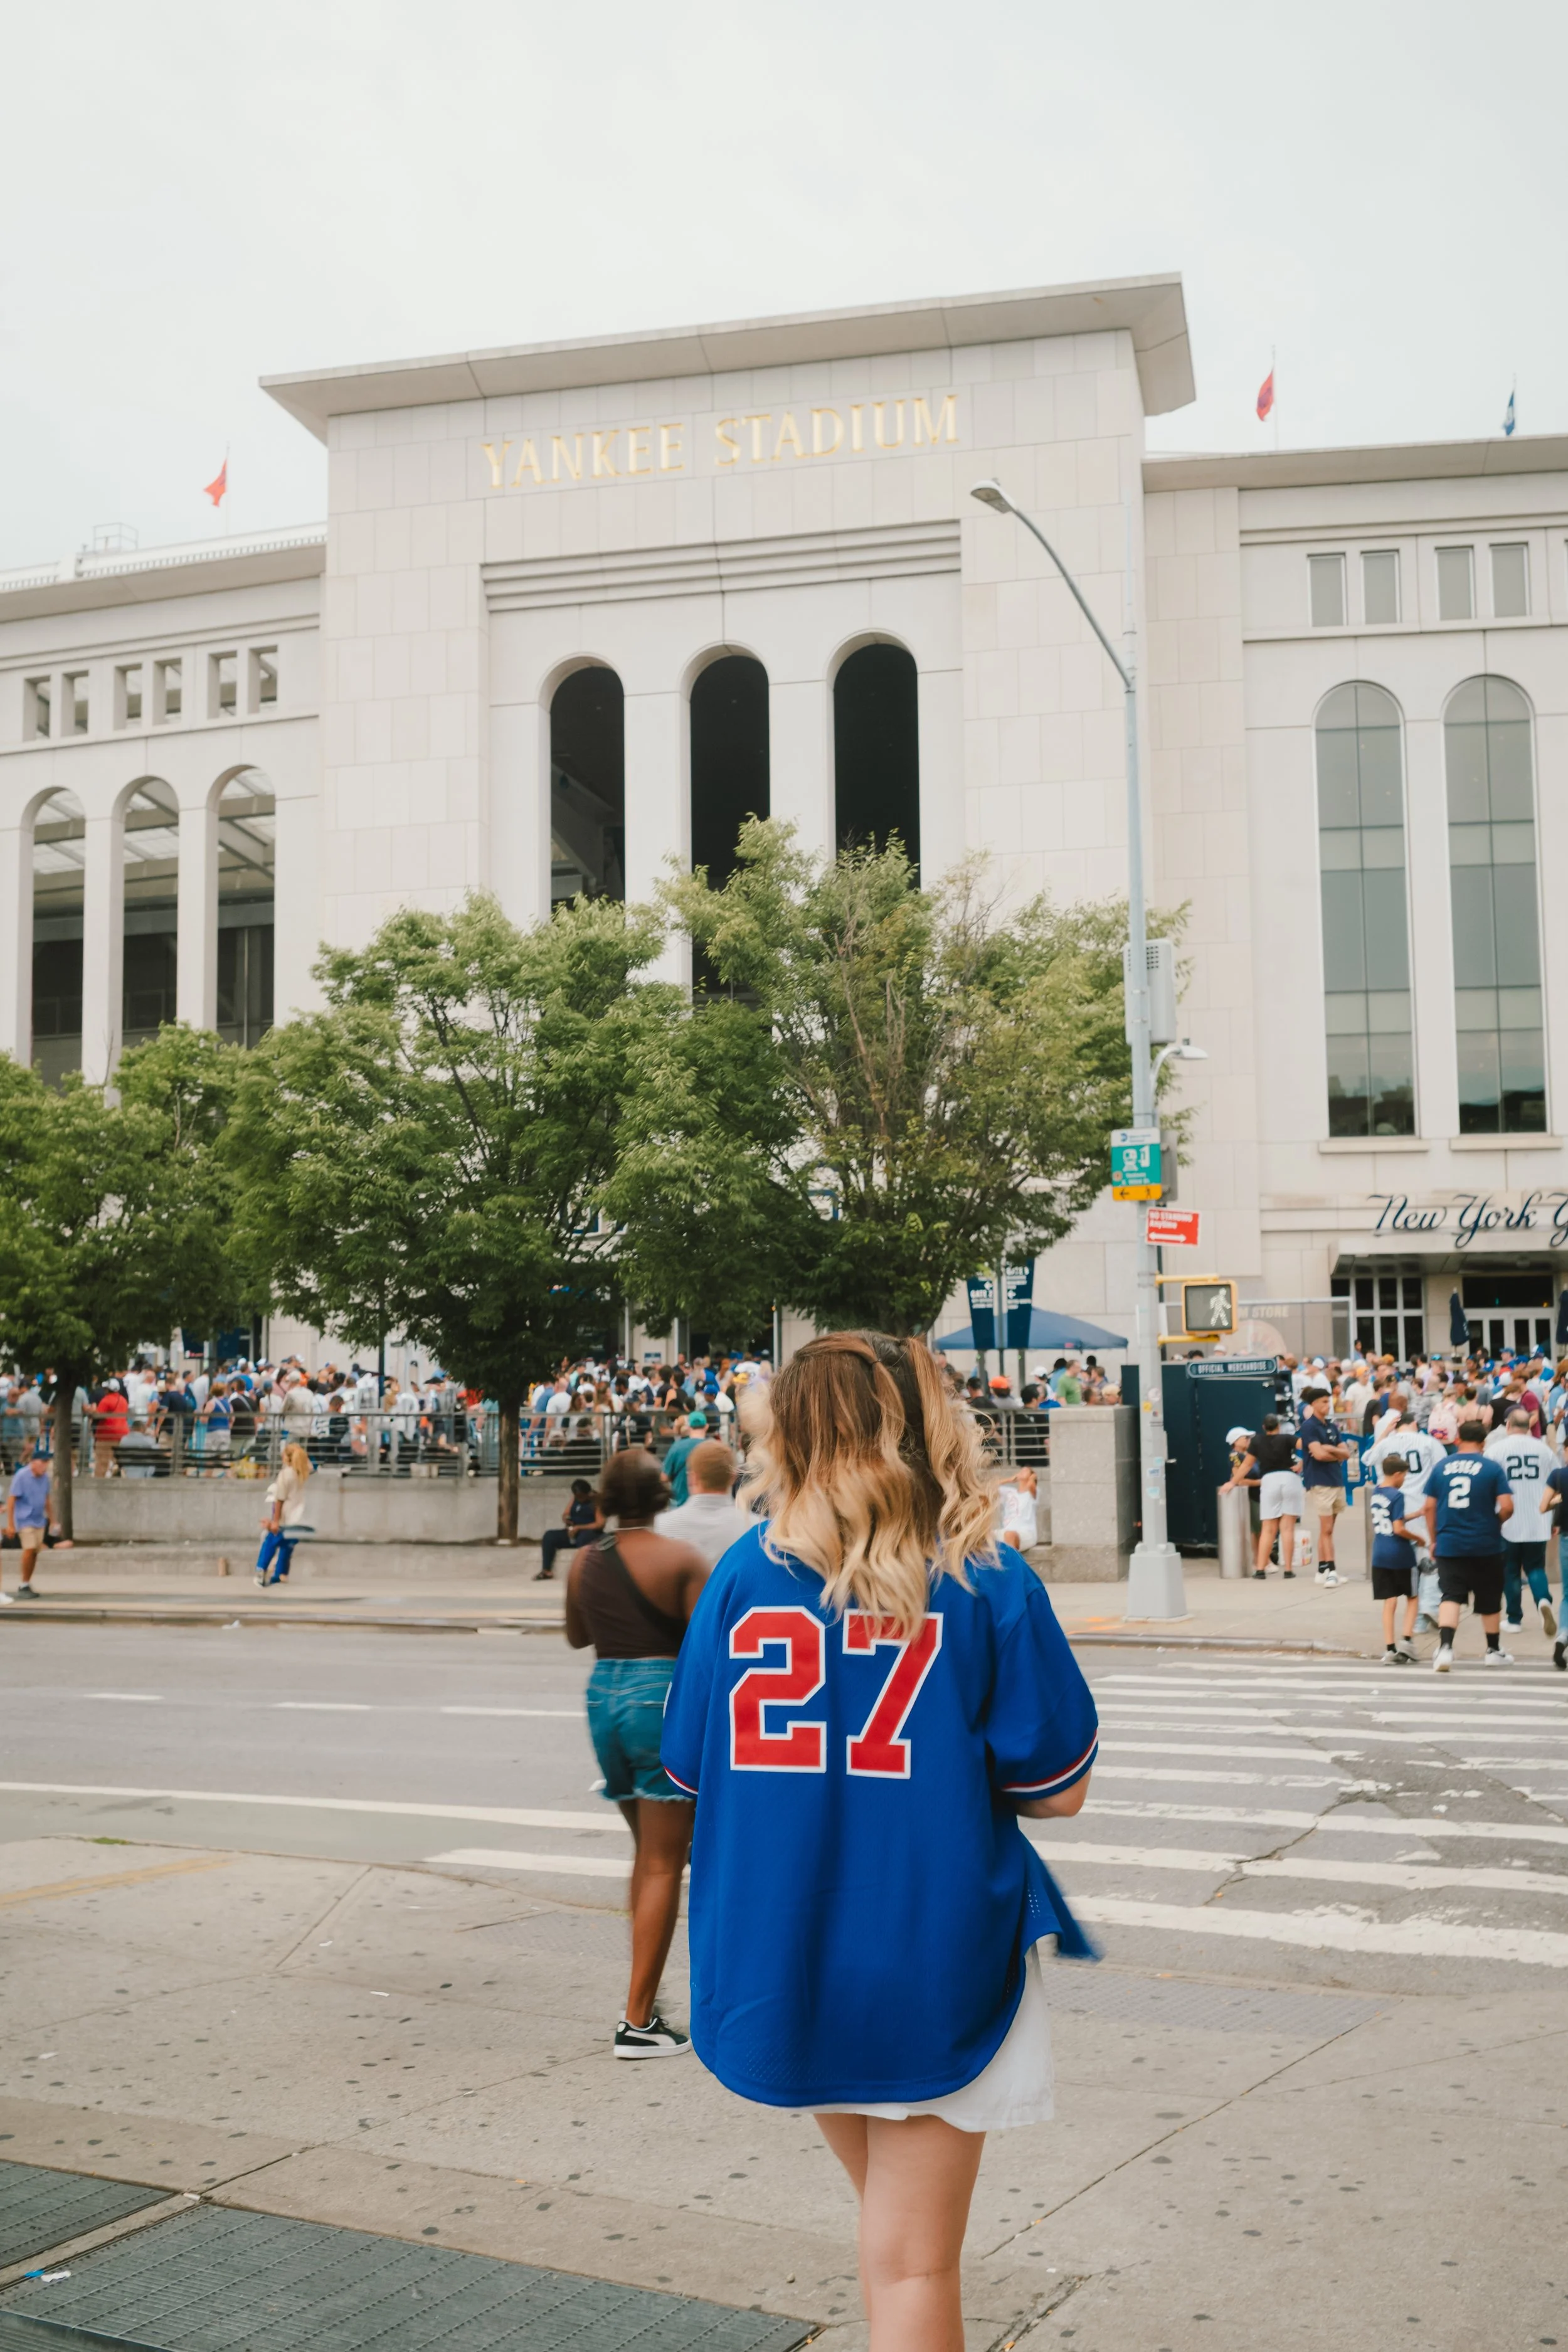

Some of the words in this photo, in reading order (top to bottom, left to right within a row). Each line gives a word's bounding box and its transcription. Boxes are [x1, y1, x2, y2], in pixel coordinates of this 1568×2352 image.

[480, 422, 685, 489] YANKEE
[714, 394, 959, 467] STADIUM
[1367, 1194, 1447, 1237] New
[1451, 1192, 1542, 1249] York
[1251, 1305, 1290, 1318] STORE
[1197, 1364, 1224, 1374] OFFICIAL
[1227, 1360, 1267, 1372] MERCHANDISE
[1507, 1455, 1540, 1480] 25
[1448, 1476, 1471, 1509] 2
[729, 1605, 944, 1779] 27
